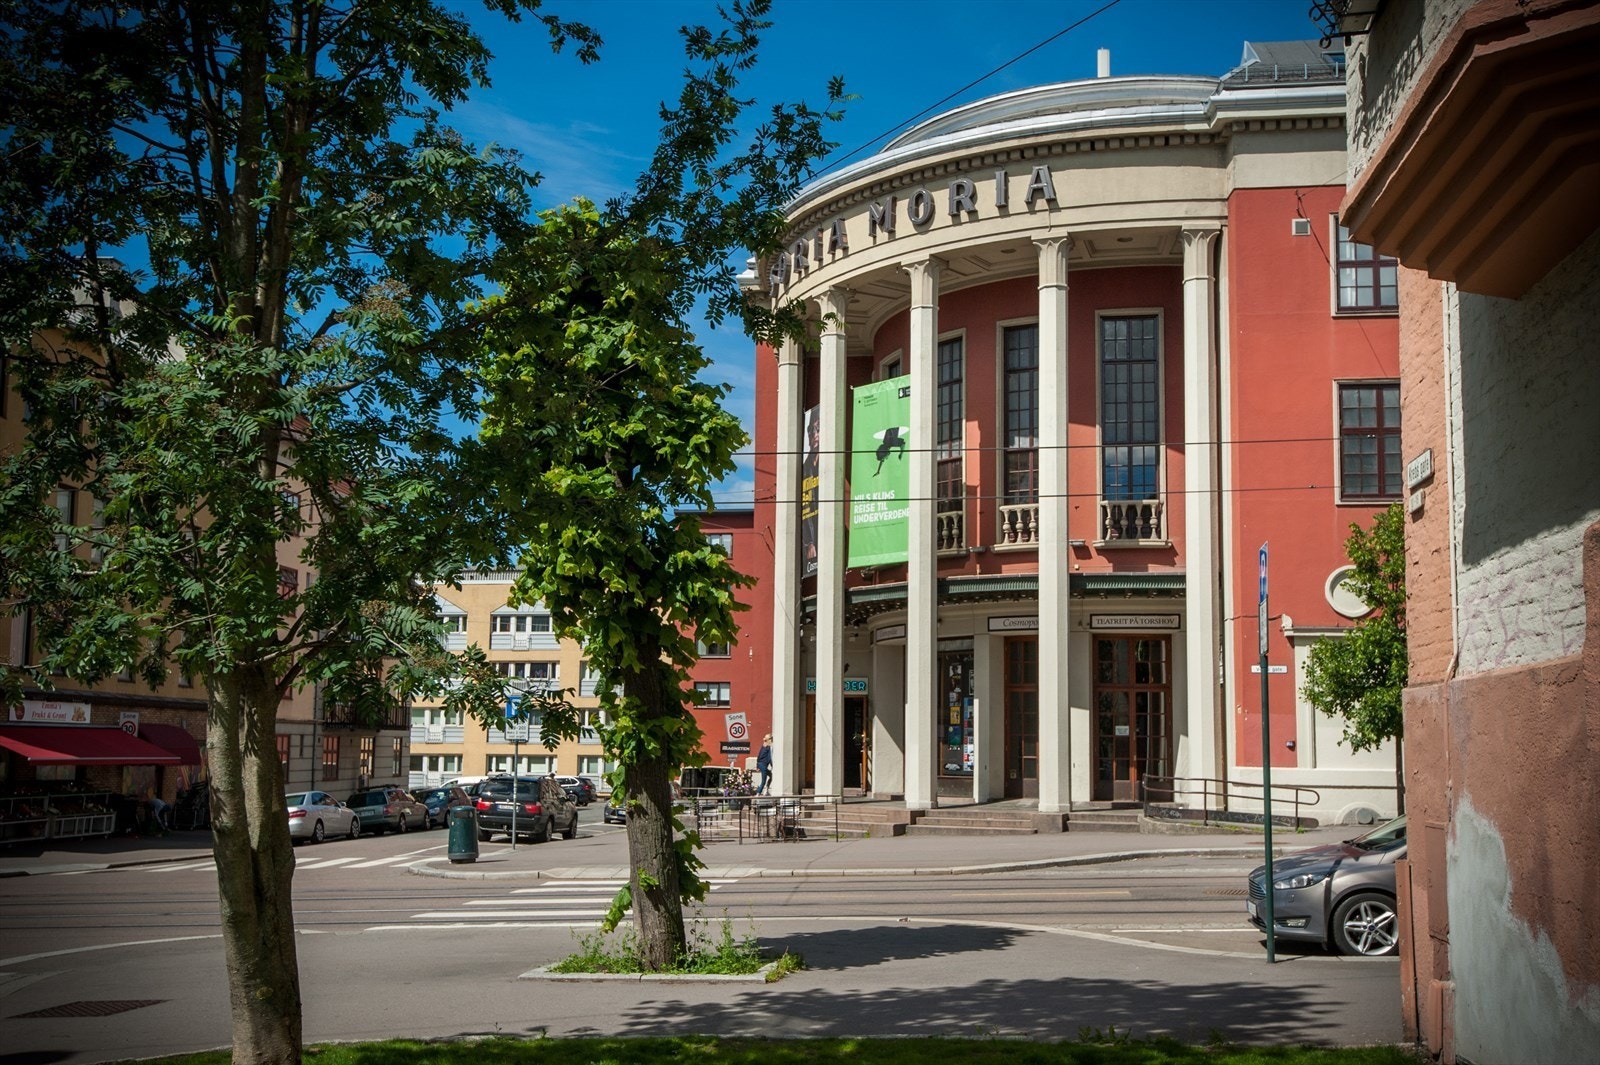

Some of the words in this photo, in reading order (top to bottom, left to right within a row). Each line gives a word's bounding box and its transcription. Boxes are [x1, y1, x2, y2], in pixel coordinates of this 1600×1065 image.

[868, 164, 1057, 238] MORIA
[872, 490, 895, 501] KLIMS
[854, 503, 875, 514] REISE
[877, 501, 888, 511] TIL
[1129, 616, 1139, 625] PÅ
[732, 725, 743, 735] 30
